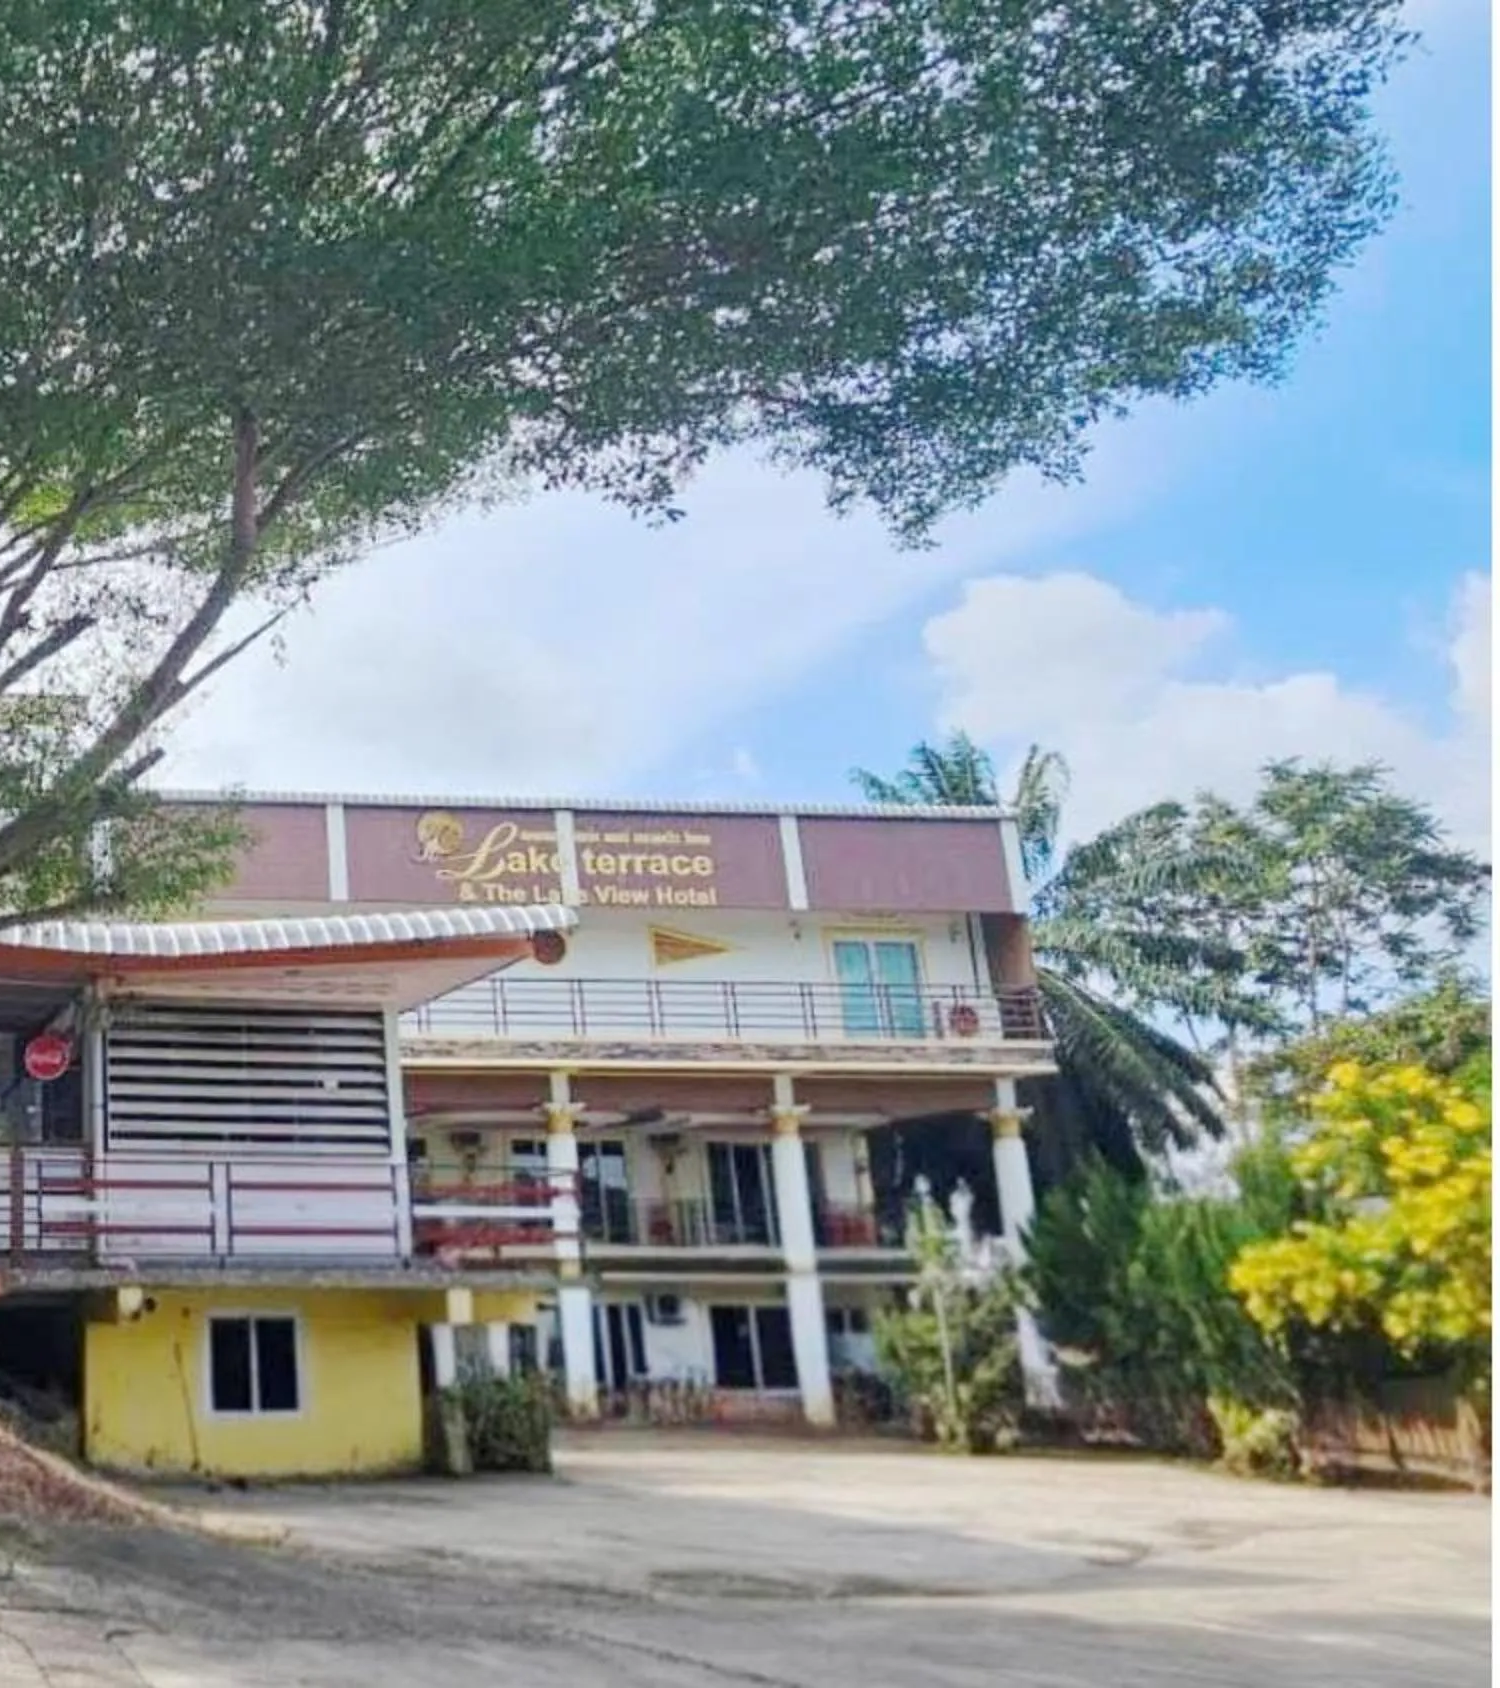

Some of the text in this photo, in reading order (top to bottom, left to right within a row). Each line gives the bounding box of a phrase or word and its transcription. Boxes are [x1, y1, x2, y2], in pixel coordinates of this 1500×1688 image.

[581, 849, 713, 876] terrace
[460, 881, 717, 906] & The Lae View Hotel
